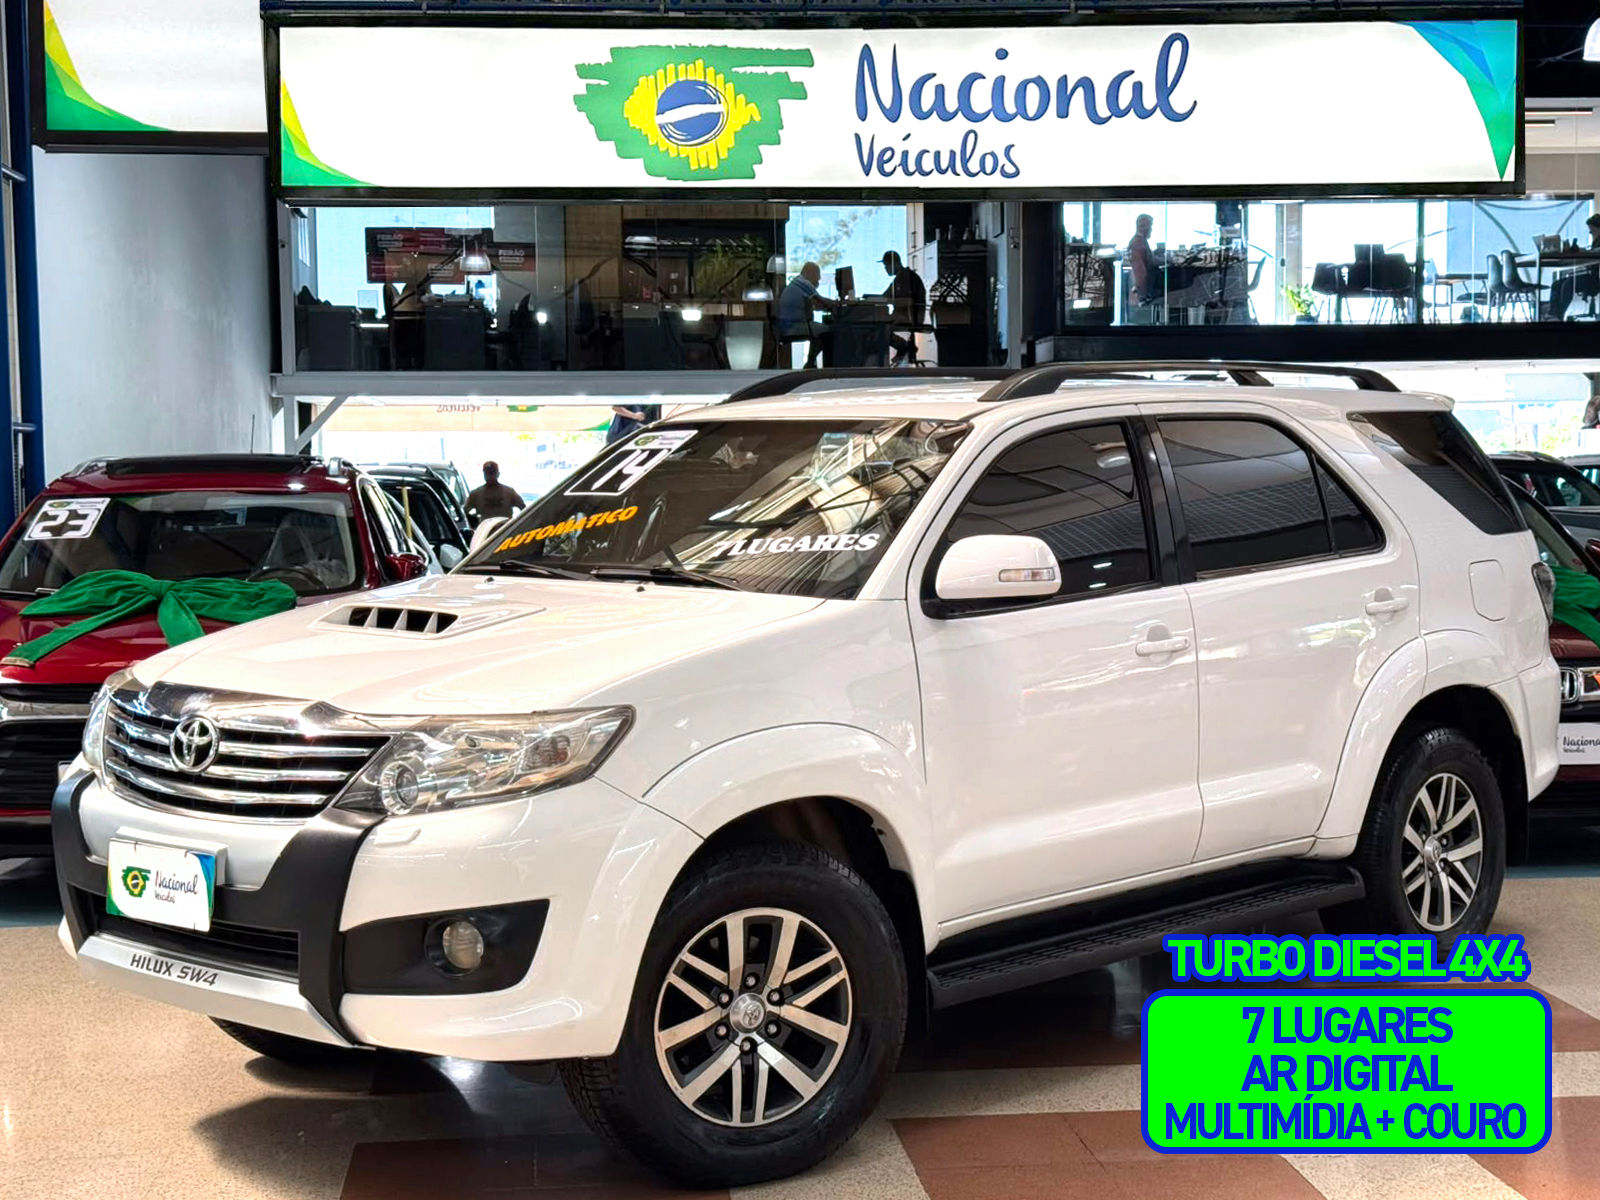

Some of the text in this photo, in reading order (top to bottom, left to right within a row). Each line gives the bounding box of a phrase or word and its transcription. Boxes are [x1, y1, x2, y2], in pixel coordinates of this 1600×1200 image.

[855, 32, 1197, 125] Nacional
[854, 129, 1021, 179] Veículos
[590, 448, 672, 492] 14
[30, 509, 99, 538] 23
[728, 533, 881, 557] LUGARES
[1562, 735, 1600, 747] Naciona
[154, 869, 199, 896] Nacional
[129, 953, 218, 987] HILUX SW4
